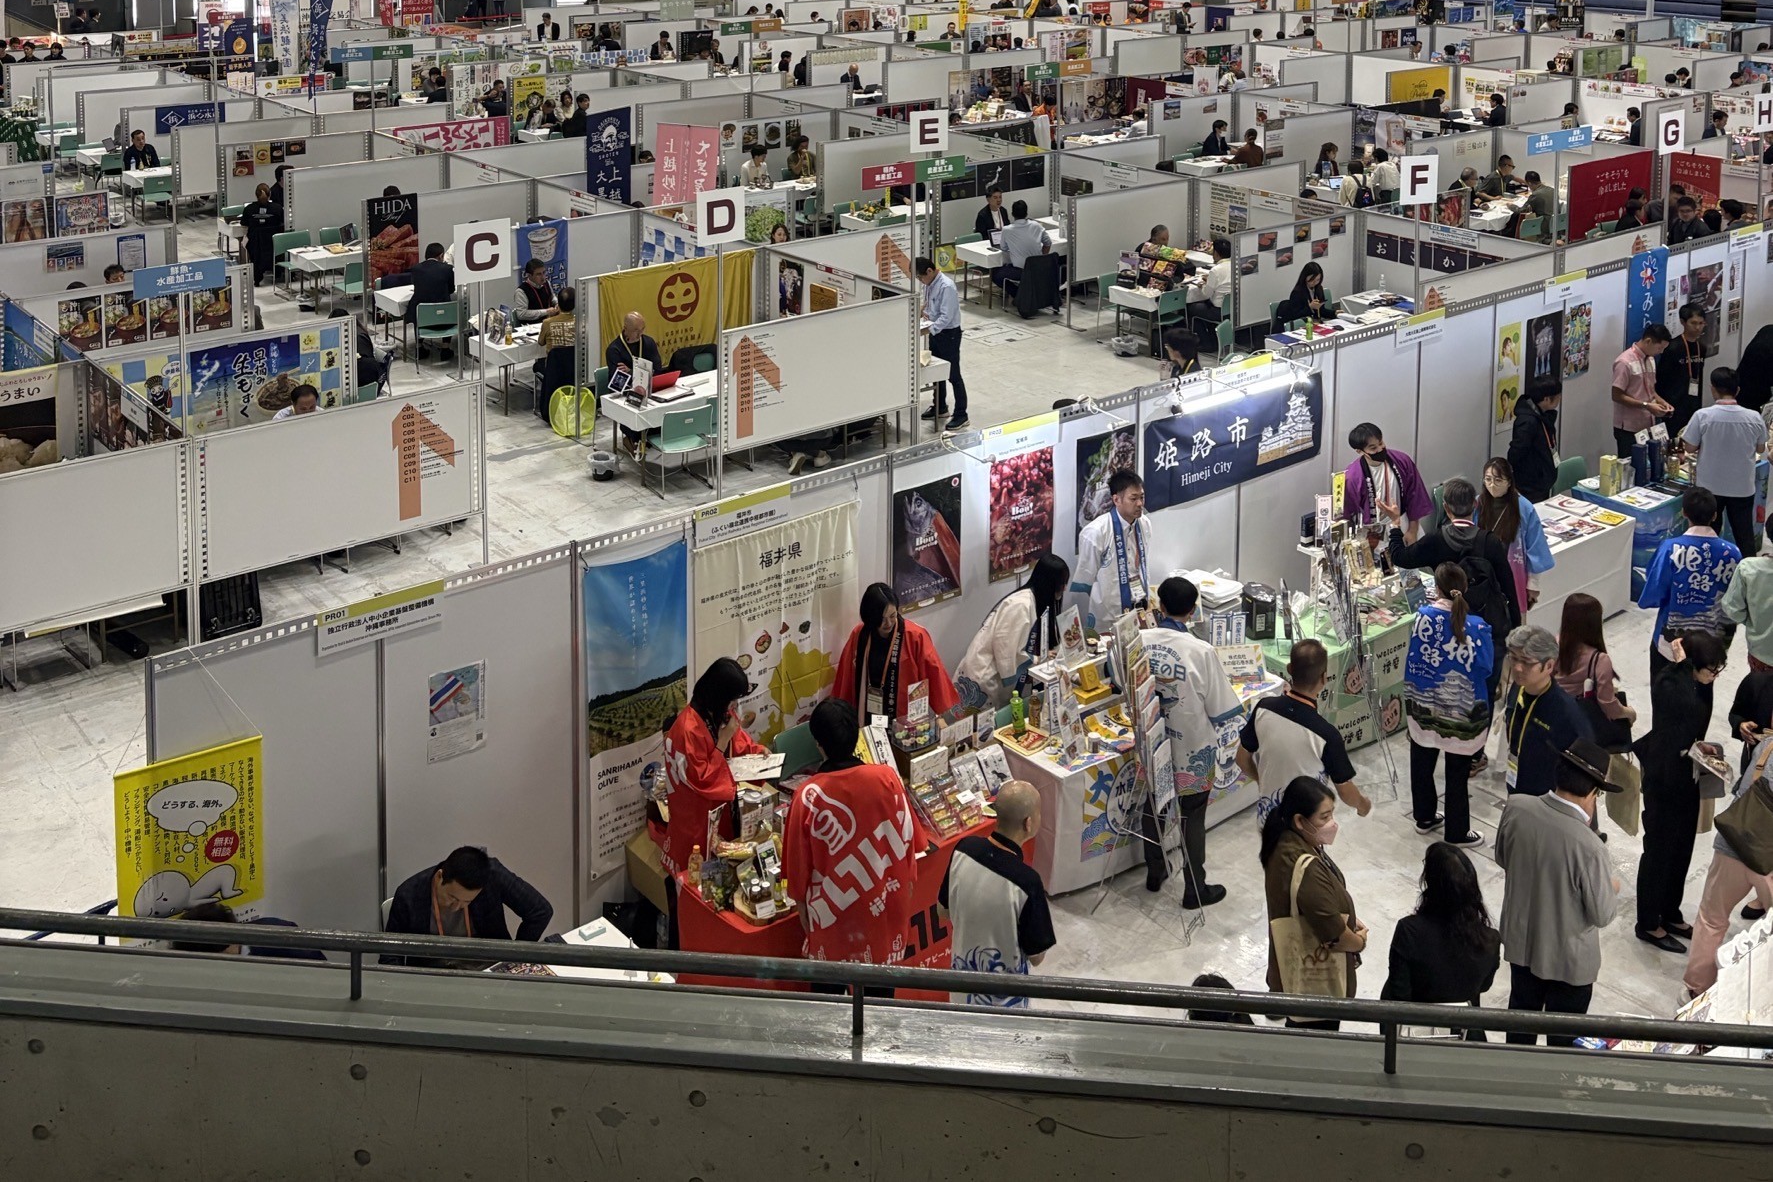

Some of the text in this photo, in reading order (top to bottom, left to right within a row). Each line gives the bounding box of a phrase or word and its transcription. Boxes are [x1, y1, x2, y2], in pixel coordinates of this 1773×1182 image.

[1758, 100, 1772, 125] H
[919, 118, 939, 145] E
[1664, 119, 1680, 146] G
[1411, 165, 1429, 196] F
[374, 198, 412, 215] HIDA
[707, 199, 736, 236] D
[465, 232, 500, 272] C
[156, 272, 203, 286] 水産加工品
[254, 349, 267, 386] 早摘み
[232, 353, 254, 418] 生もずく
[1154, 416, 1249, 472] 姫路市
[1181, 460, 1233, 486] Himeji City
[701, 508, 718, 518] PR02
[759, 541, 802, 570] 福井県
[324, 609, 346, 622] PR01
[1376, 641, 1407, 660] welcome
[597, 756, 643, 781] SANRIHAMA
[597, 776, 619, 791] OLIVE
[161, 799, 224, 810] どうする、海外。
[211, 847, 232, 858] 相談
[213, 836, 234, 847] 無料
